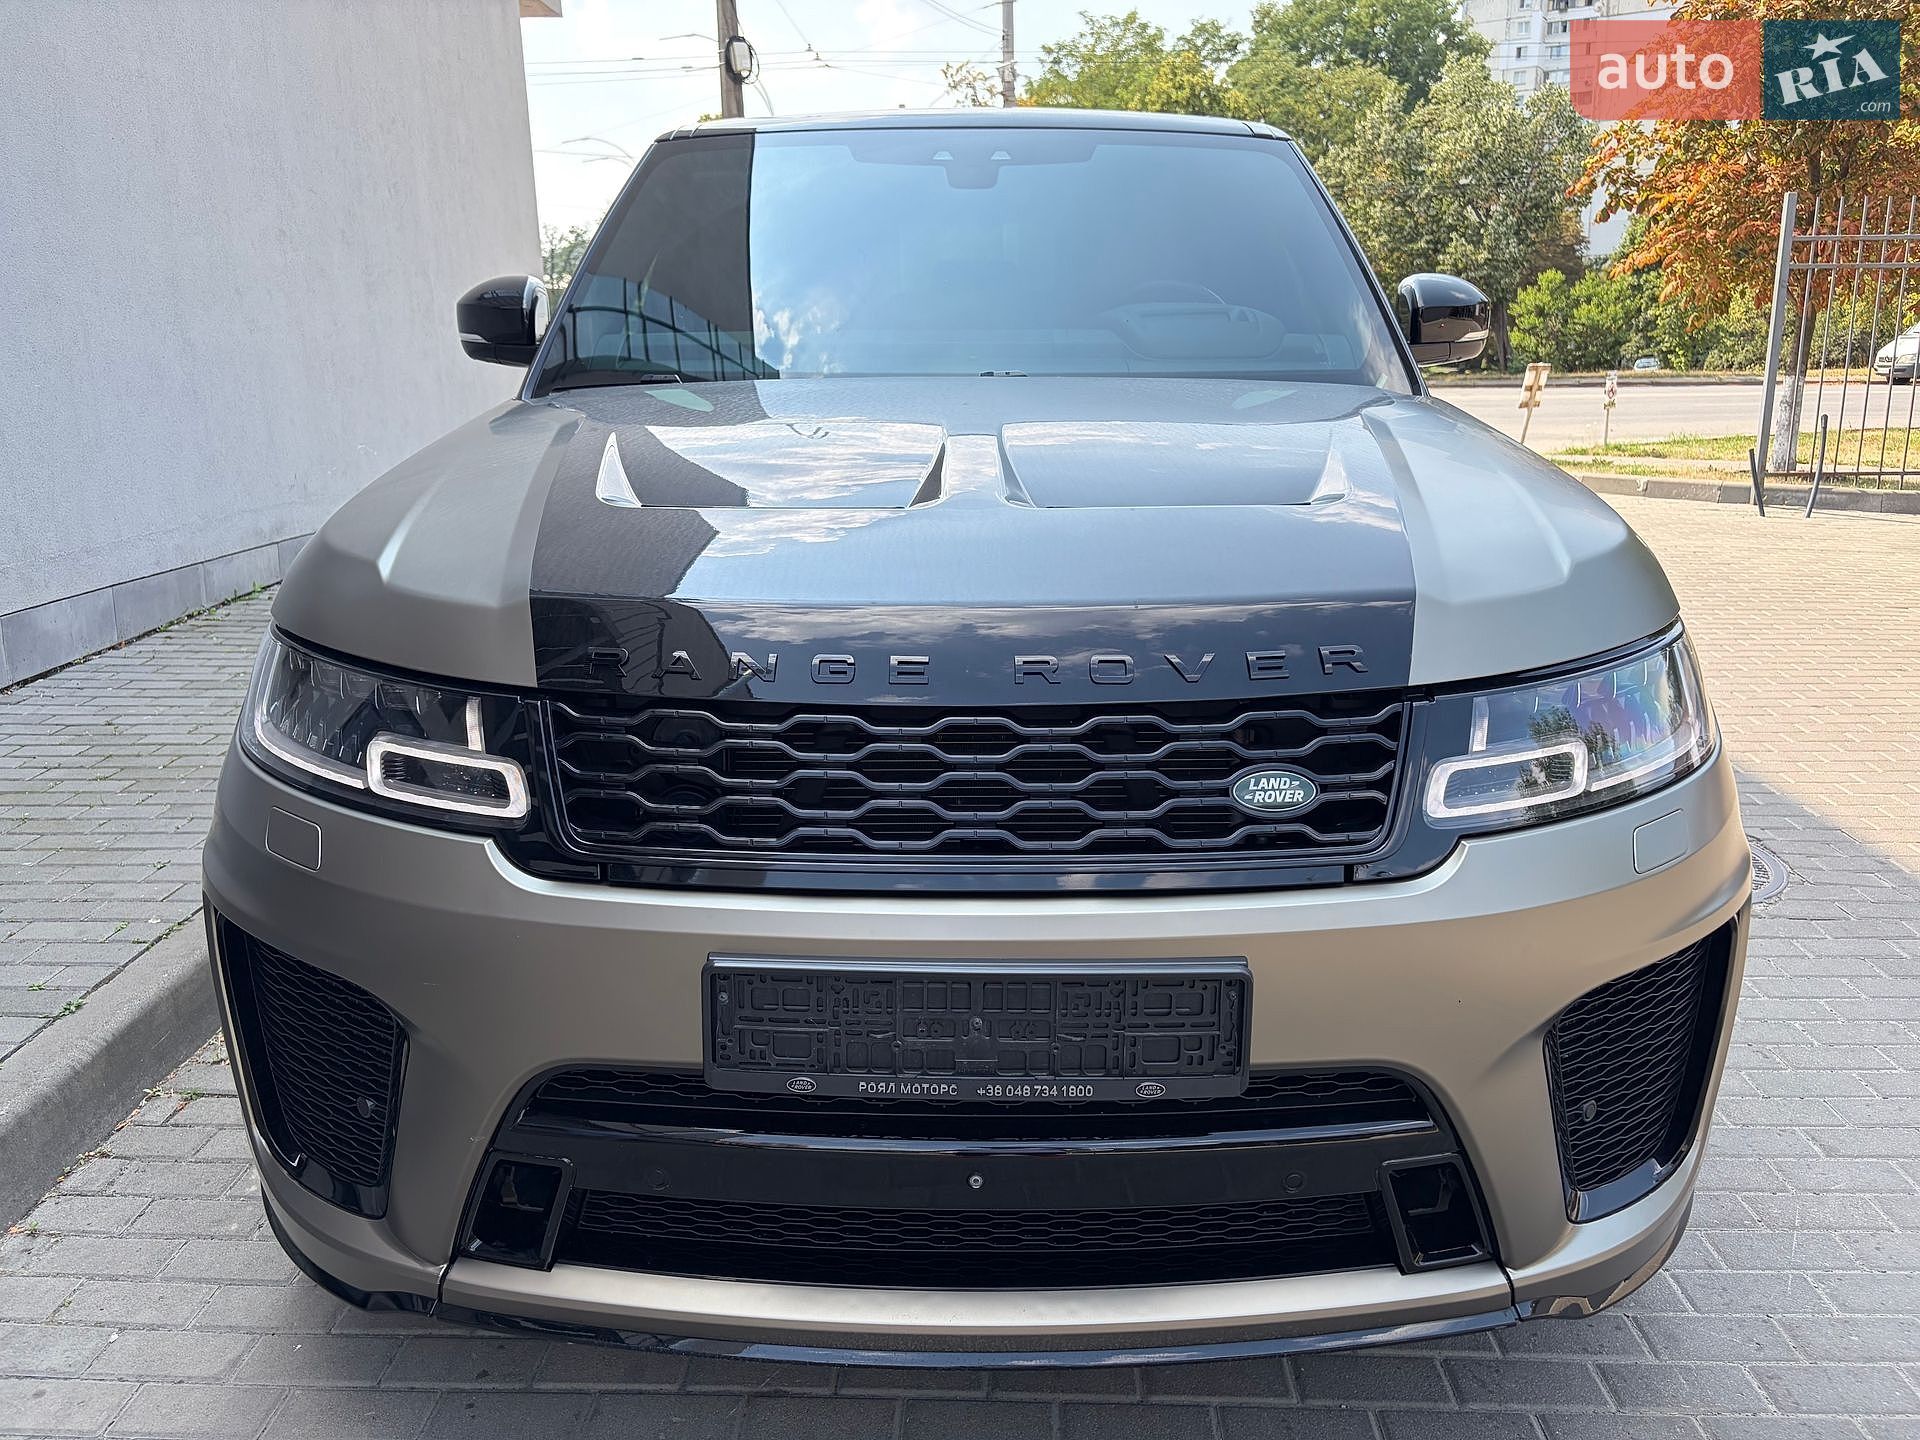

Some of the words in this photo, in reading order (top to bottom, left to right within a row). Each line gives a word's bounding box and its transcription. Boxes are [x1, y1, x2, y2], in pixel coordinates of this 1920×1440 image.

[583, 645, 931, 686] RANGE
[1013, 643, 1370, 686] ROVER
[1248, 777, 1291, 790] LAND
[1253, 789, 1305, 803] ROVER
[859, 1081, 896, 1094] РОЯЛ
[900, 1082, 958, 1095] МОТОРС
[977, 1084, 1003, 1097] +38
[1005, 1084, 1032, 1097] 048
[1033, 1084, 1058, 1097] 734
[1061, 1084, 1094, 1097] 1800
